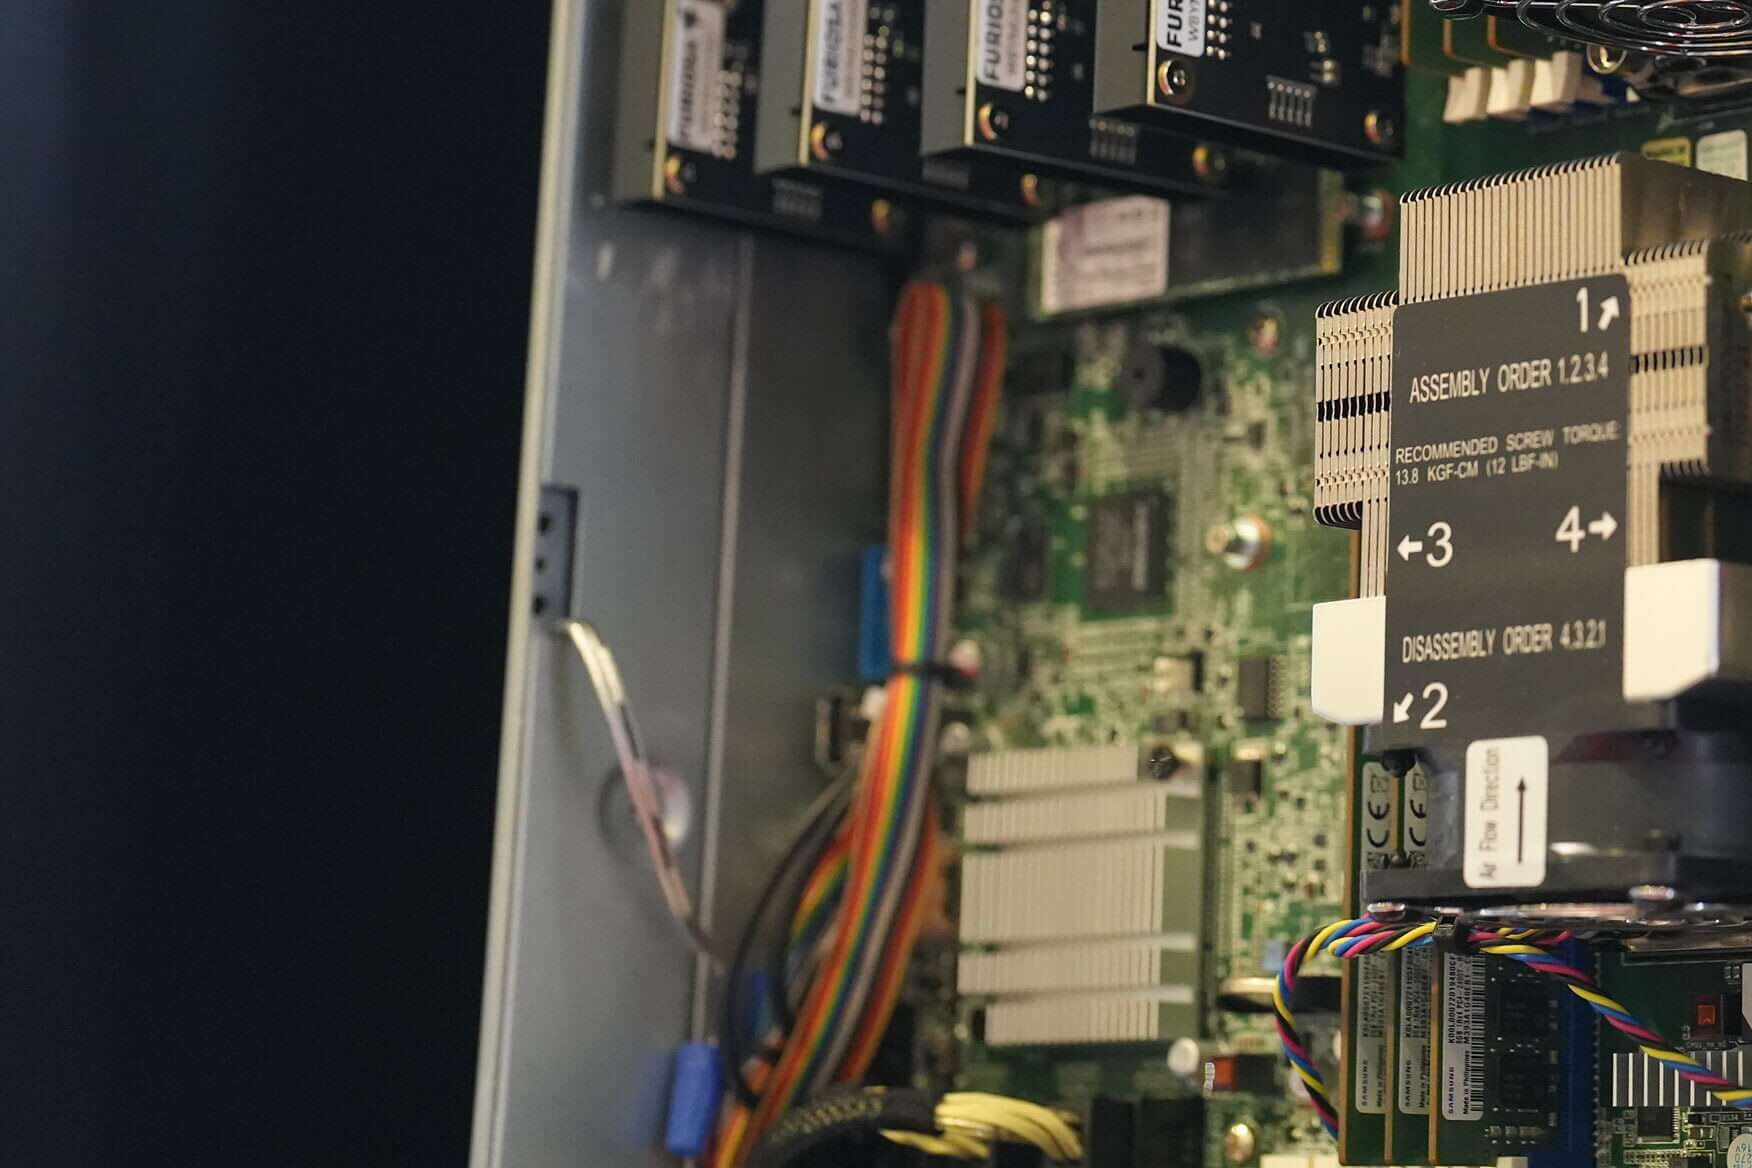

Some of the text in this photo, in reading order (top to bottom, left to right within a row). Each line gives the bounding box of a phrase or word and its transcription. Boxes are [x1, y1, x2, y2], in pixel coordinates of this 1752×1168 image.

[1576, 287, 1588, 333] 1
[1409, 367, 1490, 404] ASSEMBLY
[1498, 359, 1551, 392] ORDER
[1396, 436, 1498, 464] RECOMMENDED
[1506, 430, 1554, 451] SCREW
[1396, 467, 1418, 485] 13.8
[1427, 460, 1478, 482] KGF-CM
[1486, 458, 1505, 477] (12
[1426, 521, 1453, 567] 3
[1555, 505, 1586, 553] 4
[1402, 628, 1496, 663] DISASSEMBLY
[1503, 623, 1553, 655] ORDER
[1420, 682, 1448, 729] 2
[1480, 747, 1499, 811] Direction
[1463, 1050, 1471, 1087] Philippines
